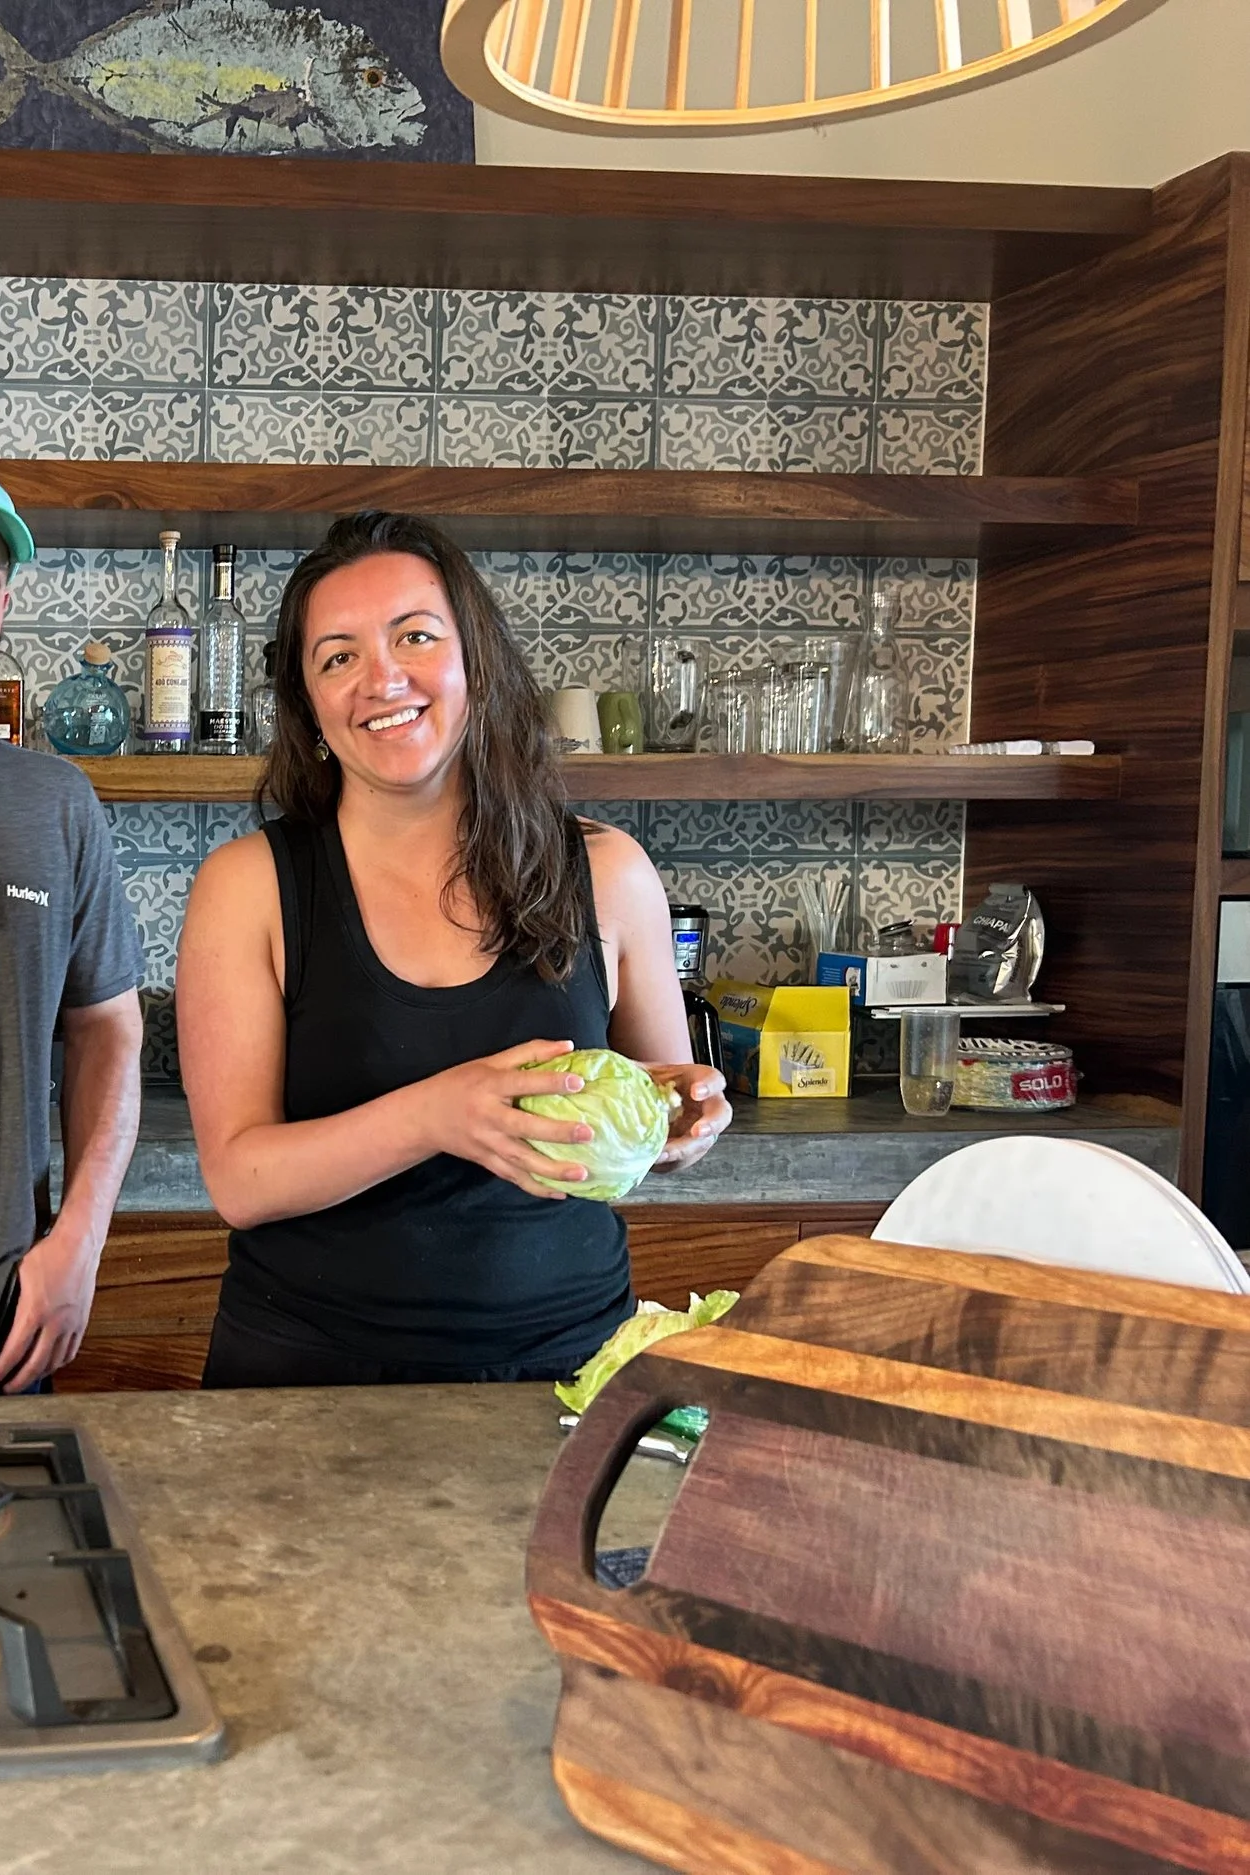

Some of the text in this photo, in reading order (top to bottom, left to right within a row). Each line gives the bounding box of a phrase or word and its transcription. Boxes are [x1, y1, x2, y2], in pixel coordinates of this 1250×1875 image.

[209, 717, 240, 725] MAESTO
[6, 884, 42, 904] Hurley
[1018, 1074, 1063, 1092] SOLO
